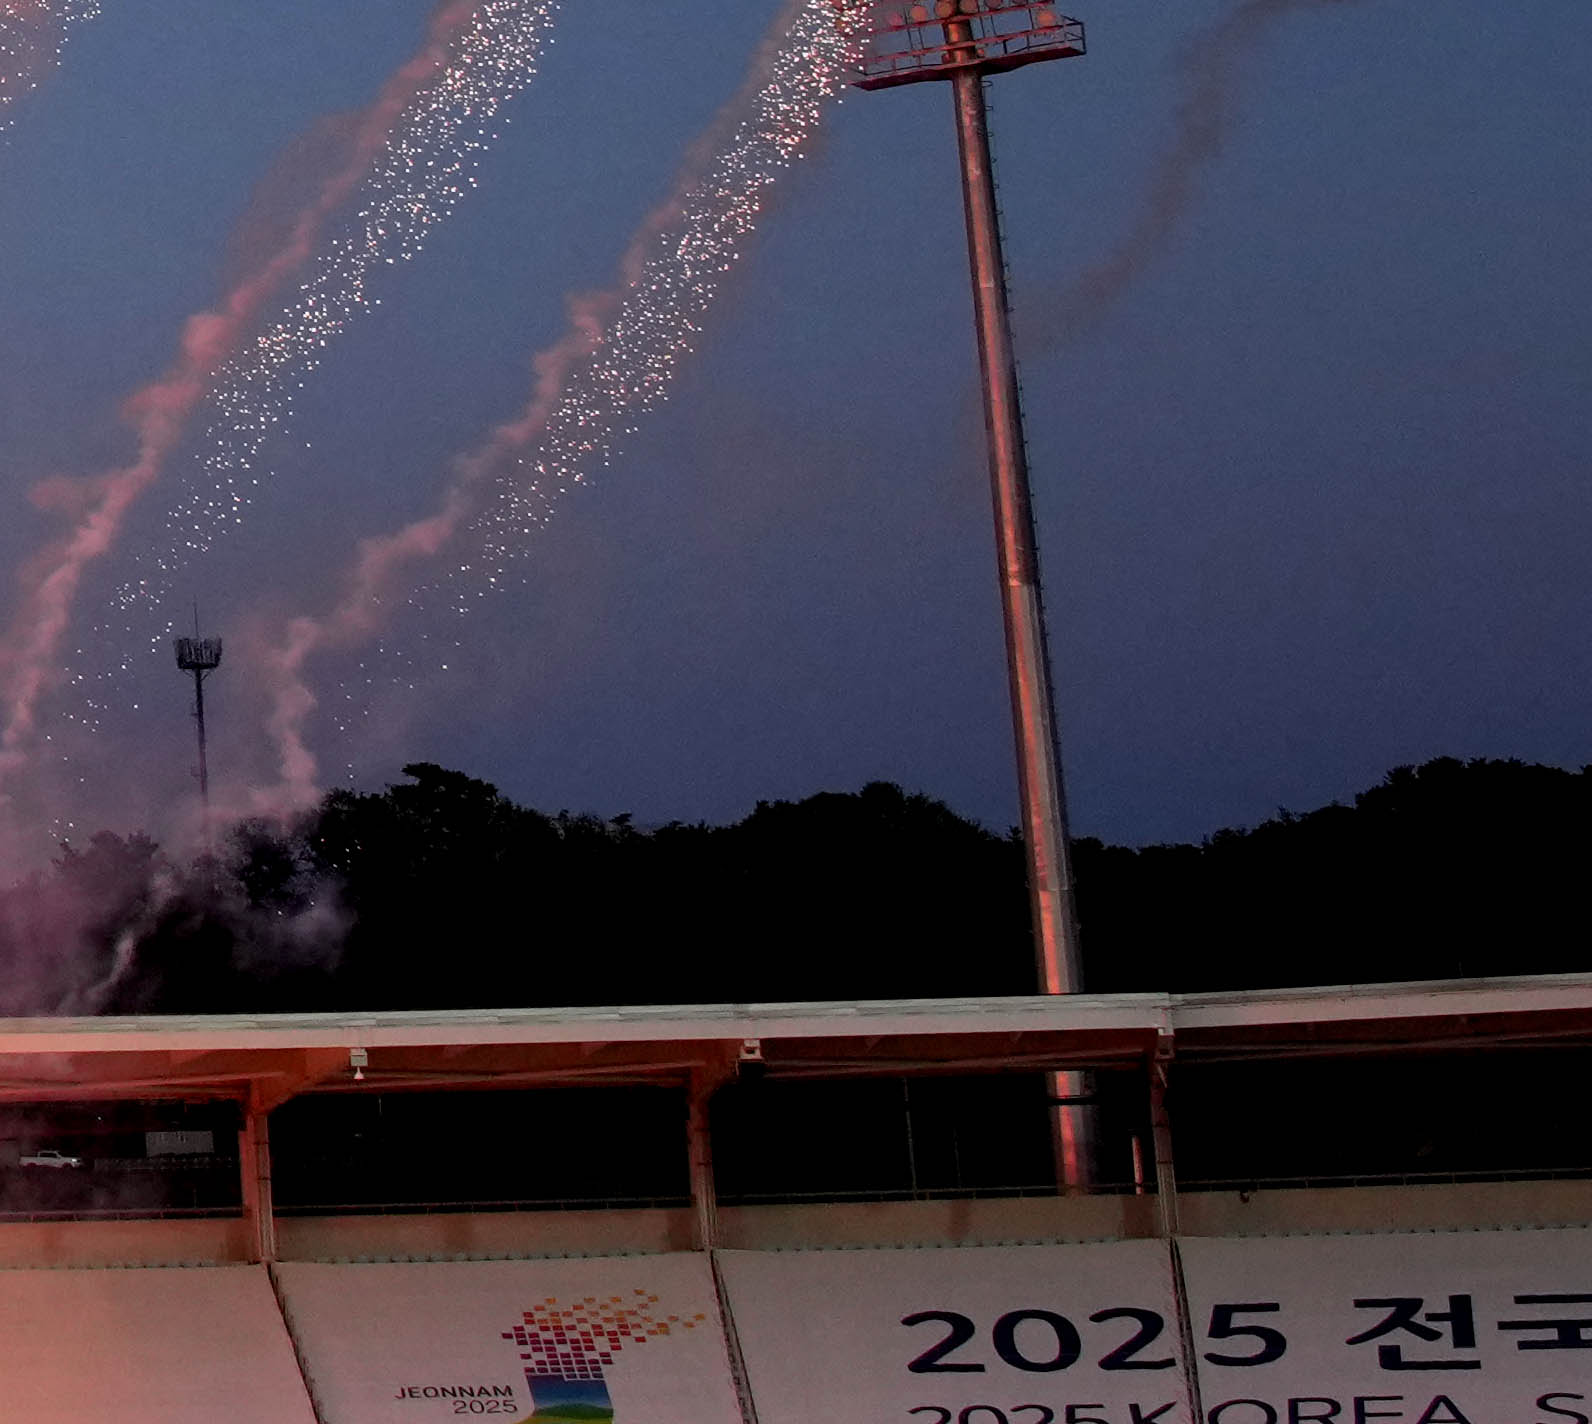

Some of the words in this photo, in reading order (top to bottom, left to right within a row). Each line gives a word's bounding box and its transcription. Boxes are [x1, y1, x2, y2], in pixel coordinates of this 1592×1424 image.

[899, 1302, 1287, 1374] 2025
[395, 1385, 513, 1401] JEONNAM
[453, 1399, 518, 1415] 2025
